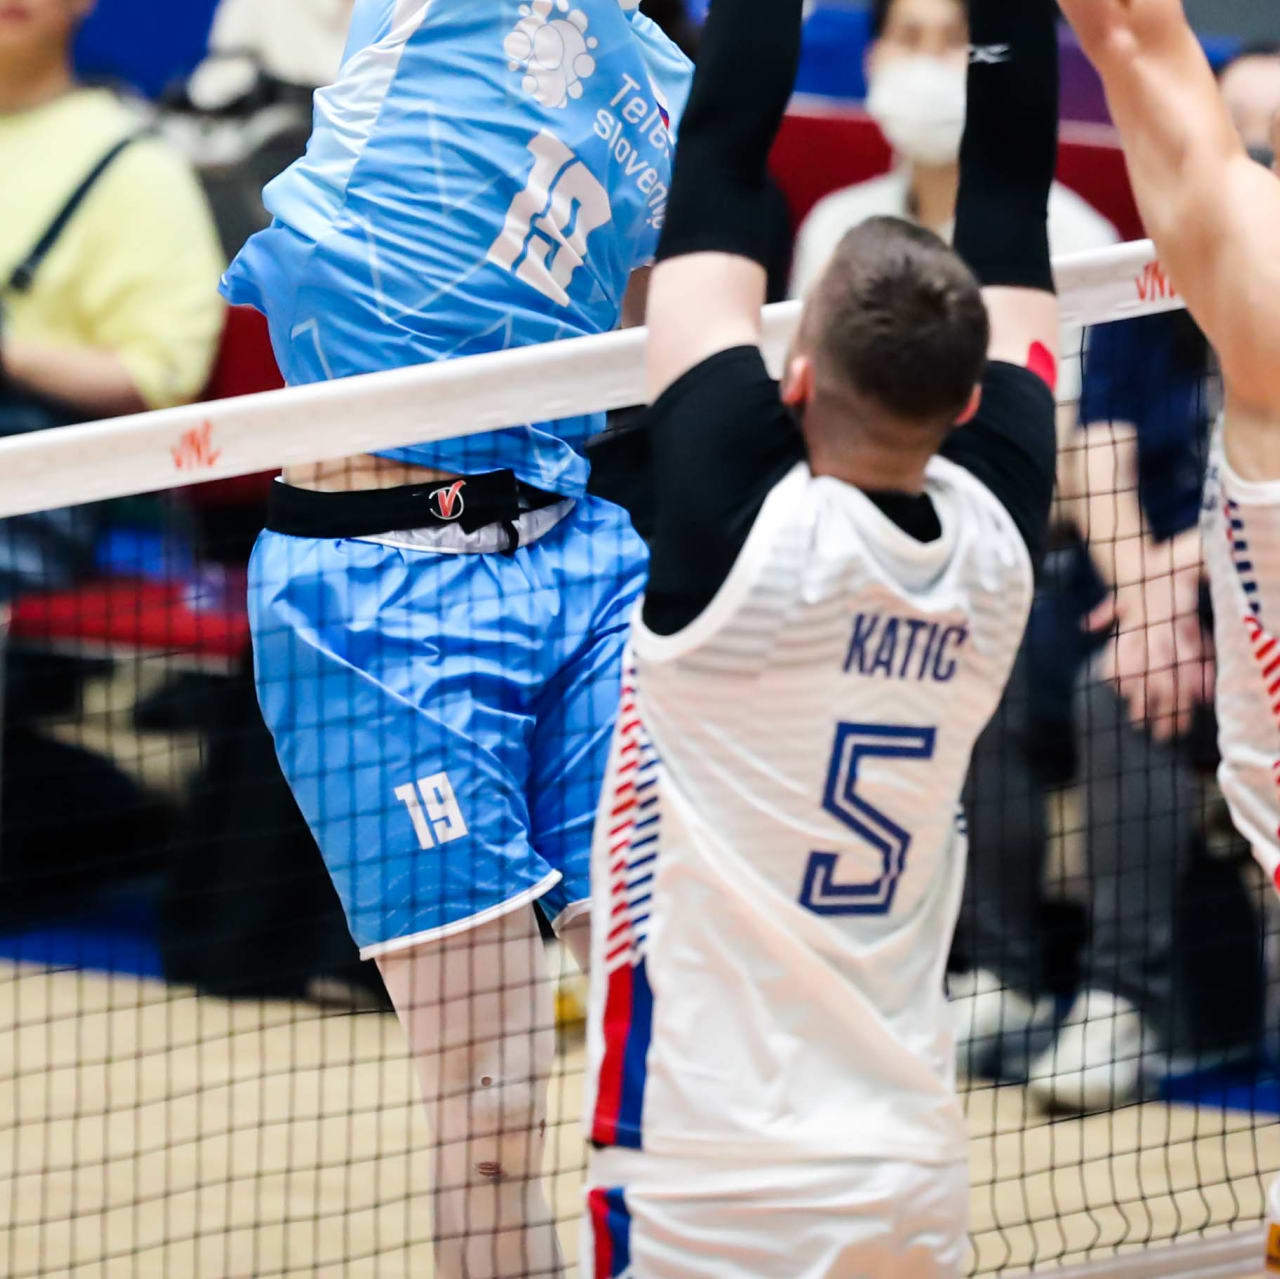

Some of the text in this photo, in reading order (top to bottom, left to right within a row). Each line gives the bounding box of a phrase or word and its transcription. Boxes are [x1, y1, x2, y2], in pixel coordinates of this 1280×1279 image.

[486, 127, 613, 308] 19
[394, 771, 470, 850] 19
[798, 722, 936, 916] 5
